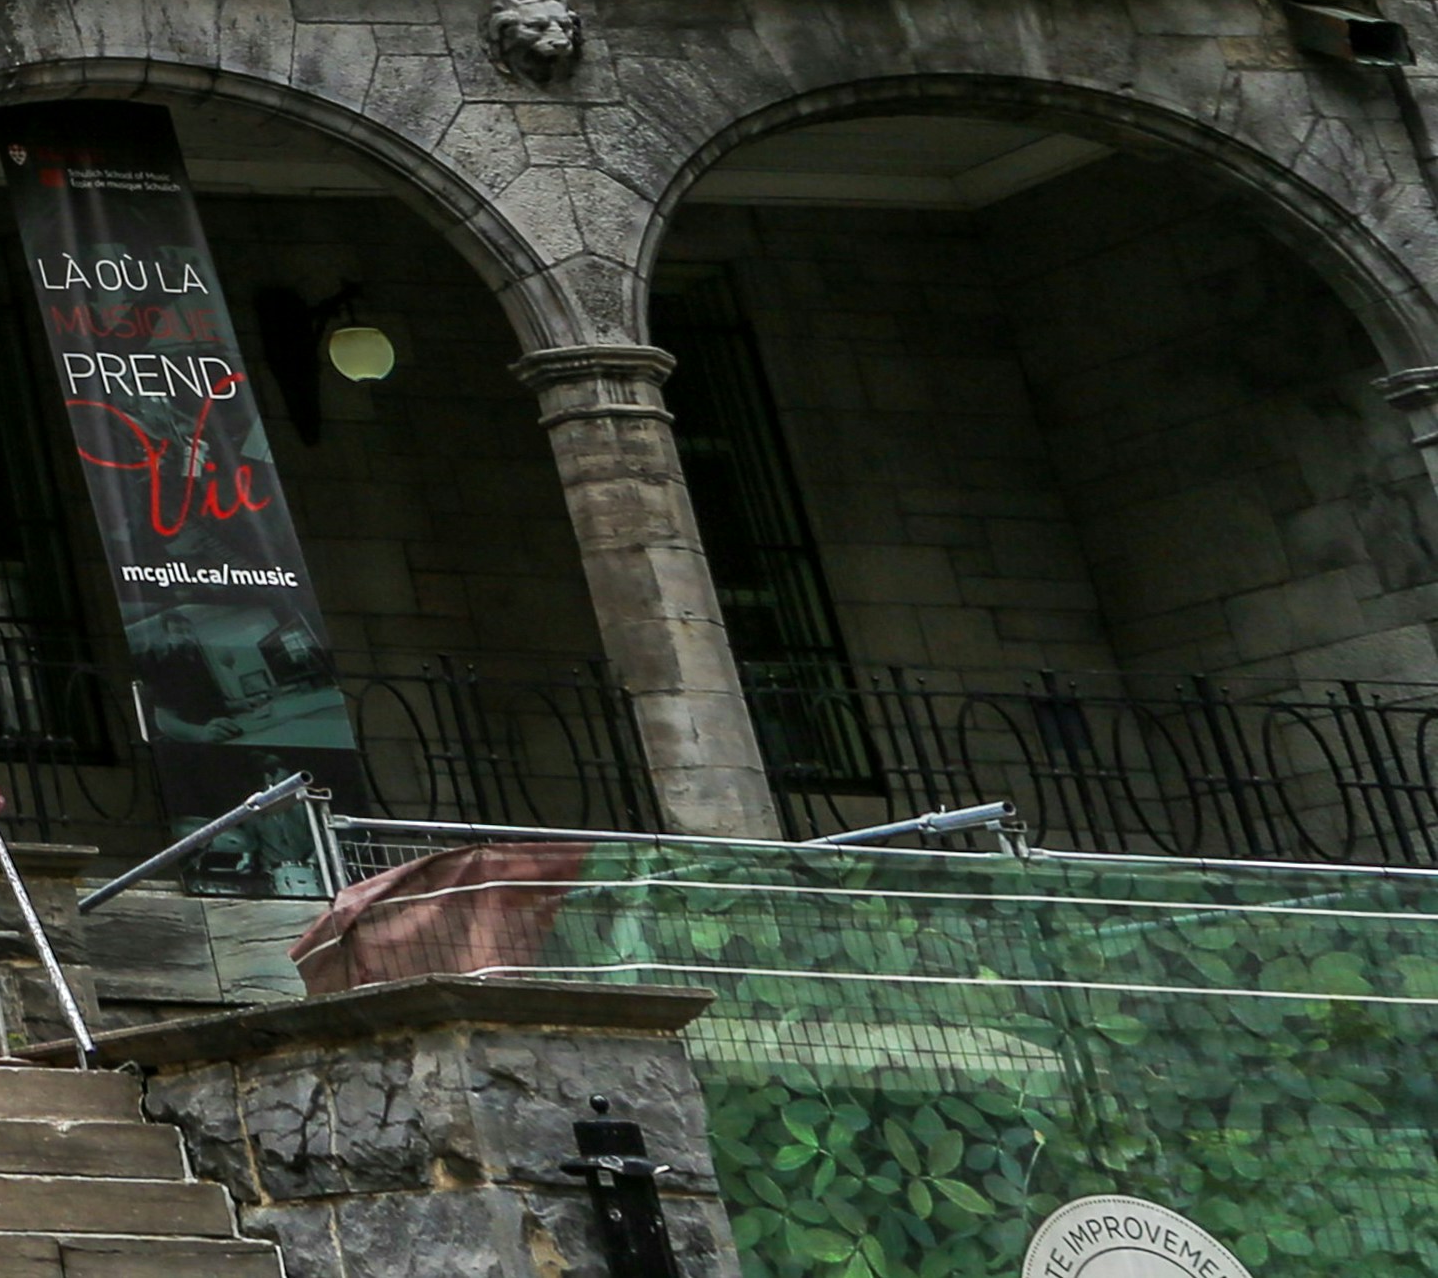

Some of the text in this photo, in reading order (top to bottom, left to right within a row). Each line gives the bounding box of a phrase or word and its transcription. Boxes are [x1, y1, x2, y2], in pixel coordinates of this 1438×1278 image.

[38, 252, 209, 294] LÀ OÙ LA
[49, 305, 225, 342] MUSIQUE
[62, 352, 236, 400] PREND
[65, 372, 273, 537] Vie
[121, 562, 299, 588] mcgill.ca/music
[1062, 1215, 1230, 1278] IMPROVEME
